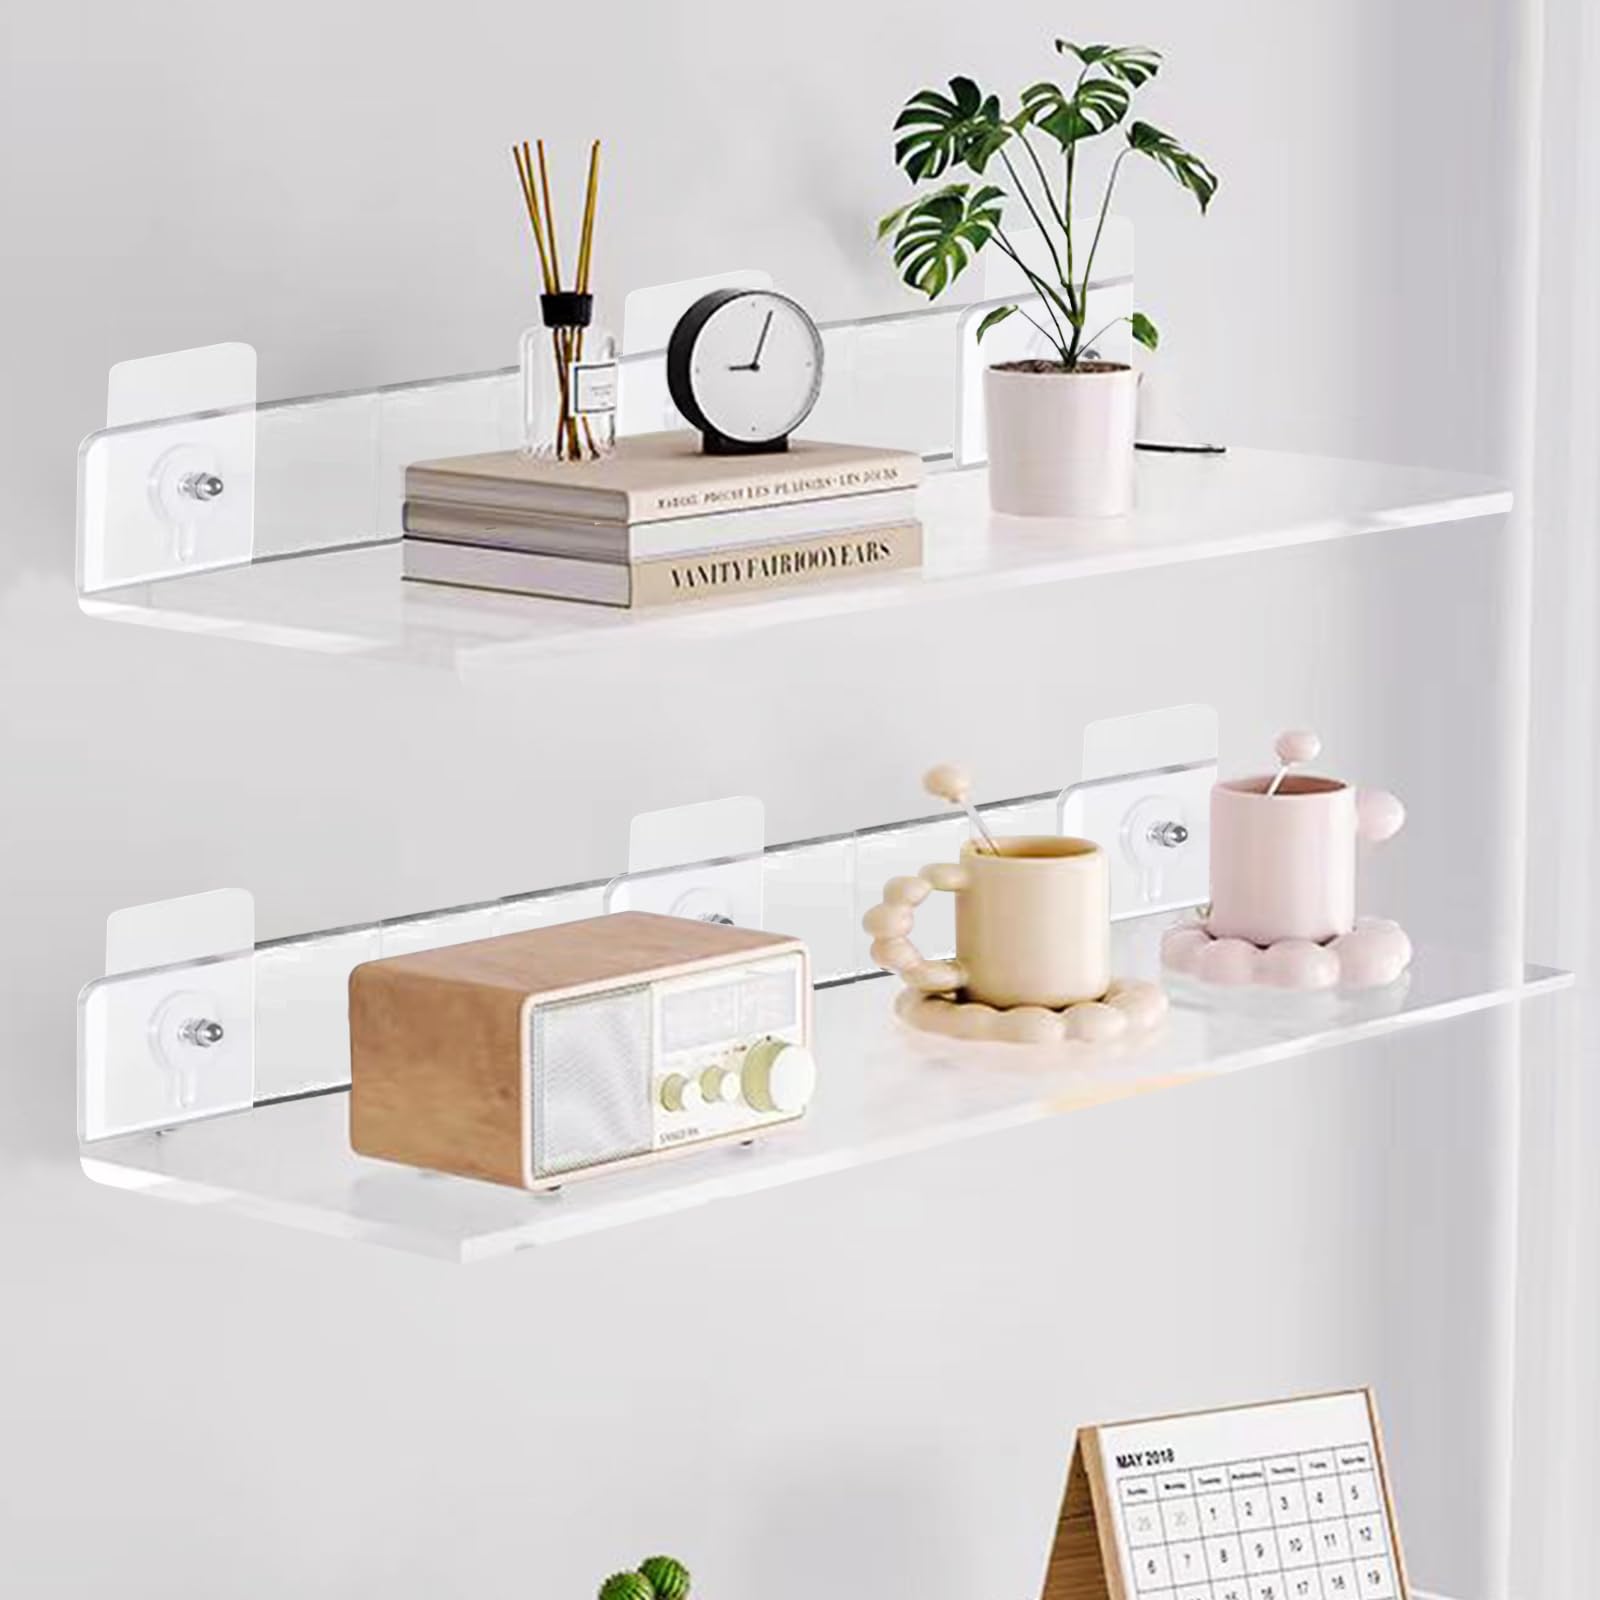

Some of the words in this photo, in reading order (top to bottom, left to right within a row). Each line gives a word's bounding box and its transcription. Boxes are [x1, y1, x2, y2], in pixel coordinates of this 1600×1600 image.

[1116, 1453, 1143, 1468] MAY
[1145, 1448, 1175, 1466] 2018
[1244, 1501, 1253, 1517] 2
[1280, 1496, 1289, 1511] 3
[1315, 1491, 1324, 1505] 4
[1350, 1485, 1359, 1501] 5
[1147, 1559, 1157, 1575] 6
[1220, 1548, 1229, 1564] 8
[1254, 1543, 1264, 1559] 9
[1289, 1537, 1303, 1553] 10
[1323, 1532, 1337, 1548] 11
[1359, 1526, 1373, 1542] 12
[1367, 1569, 1381, 1585] 19
